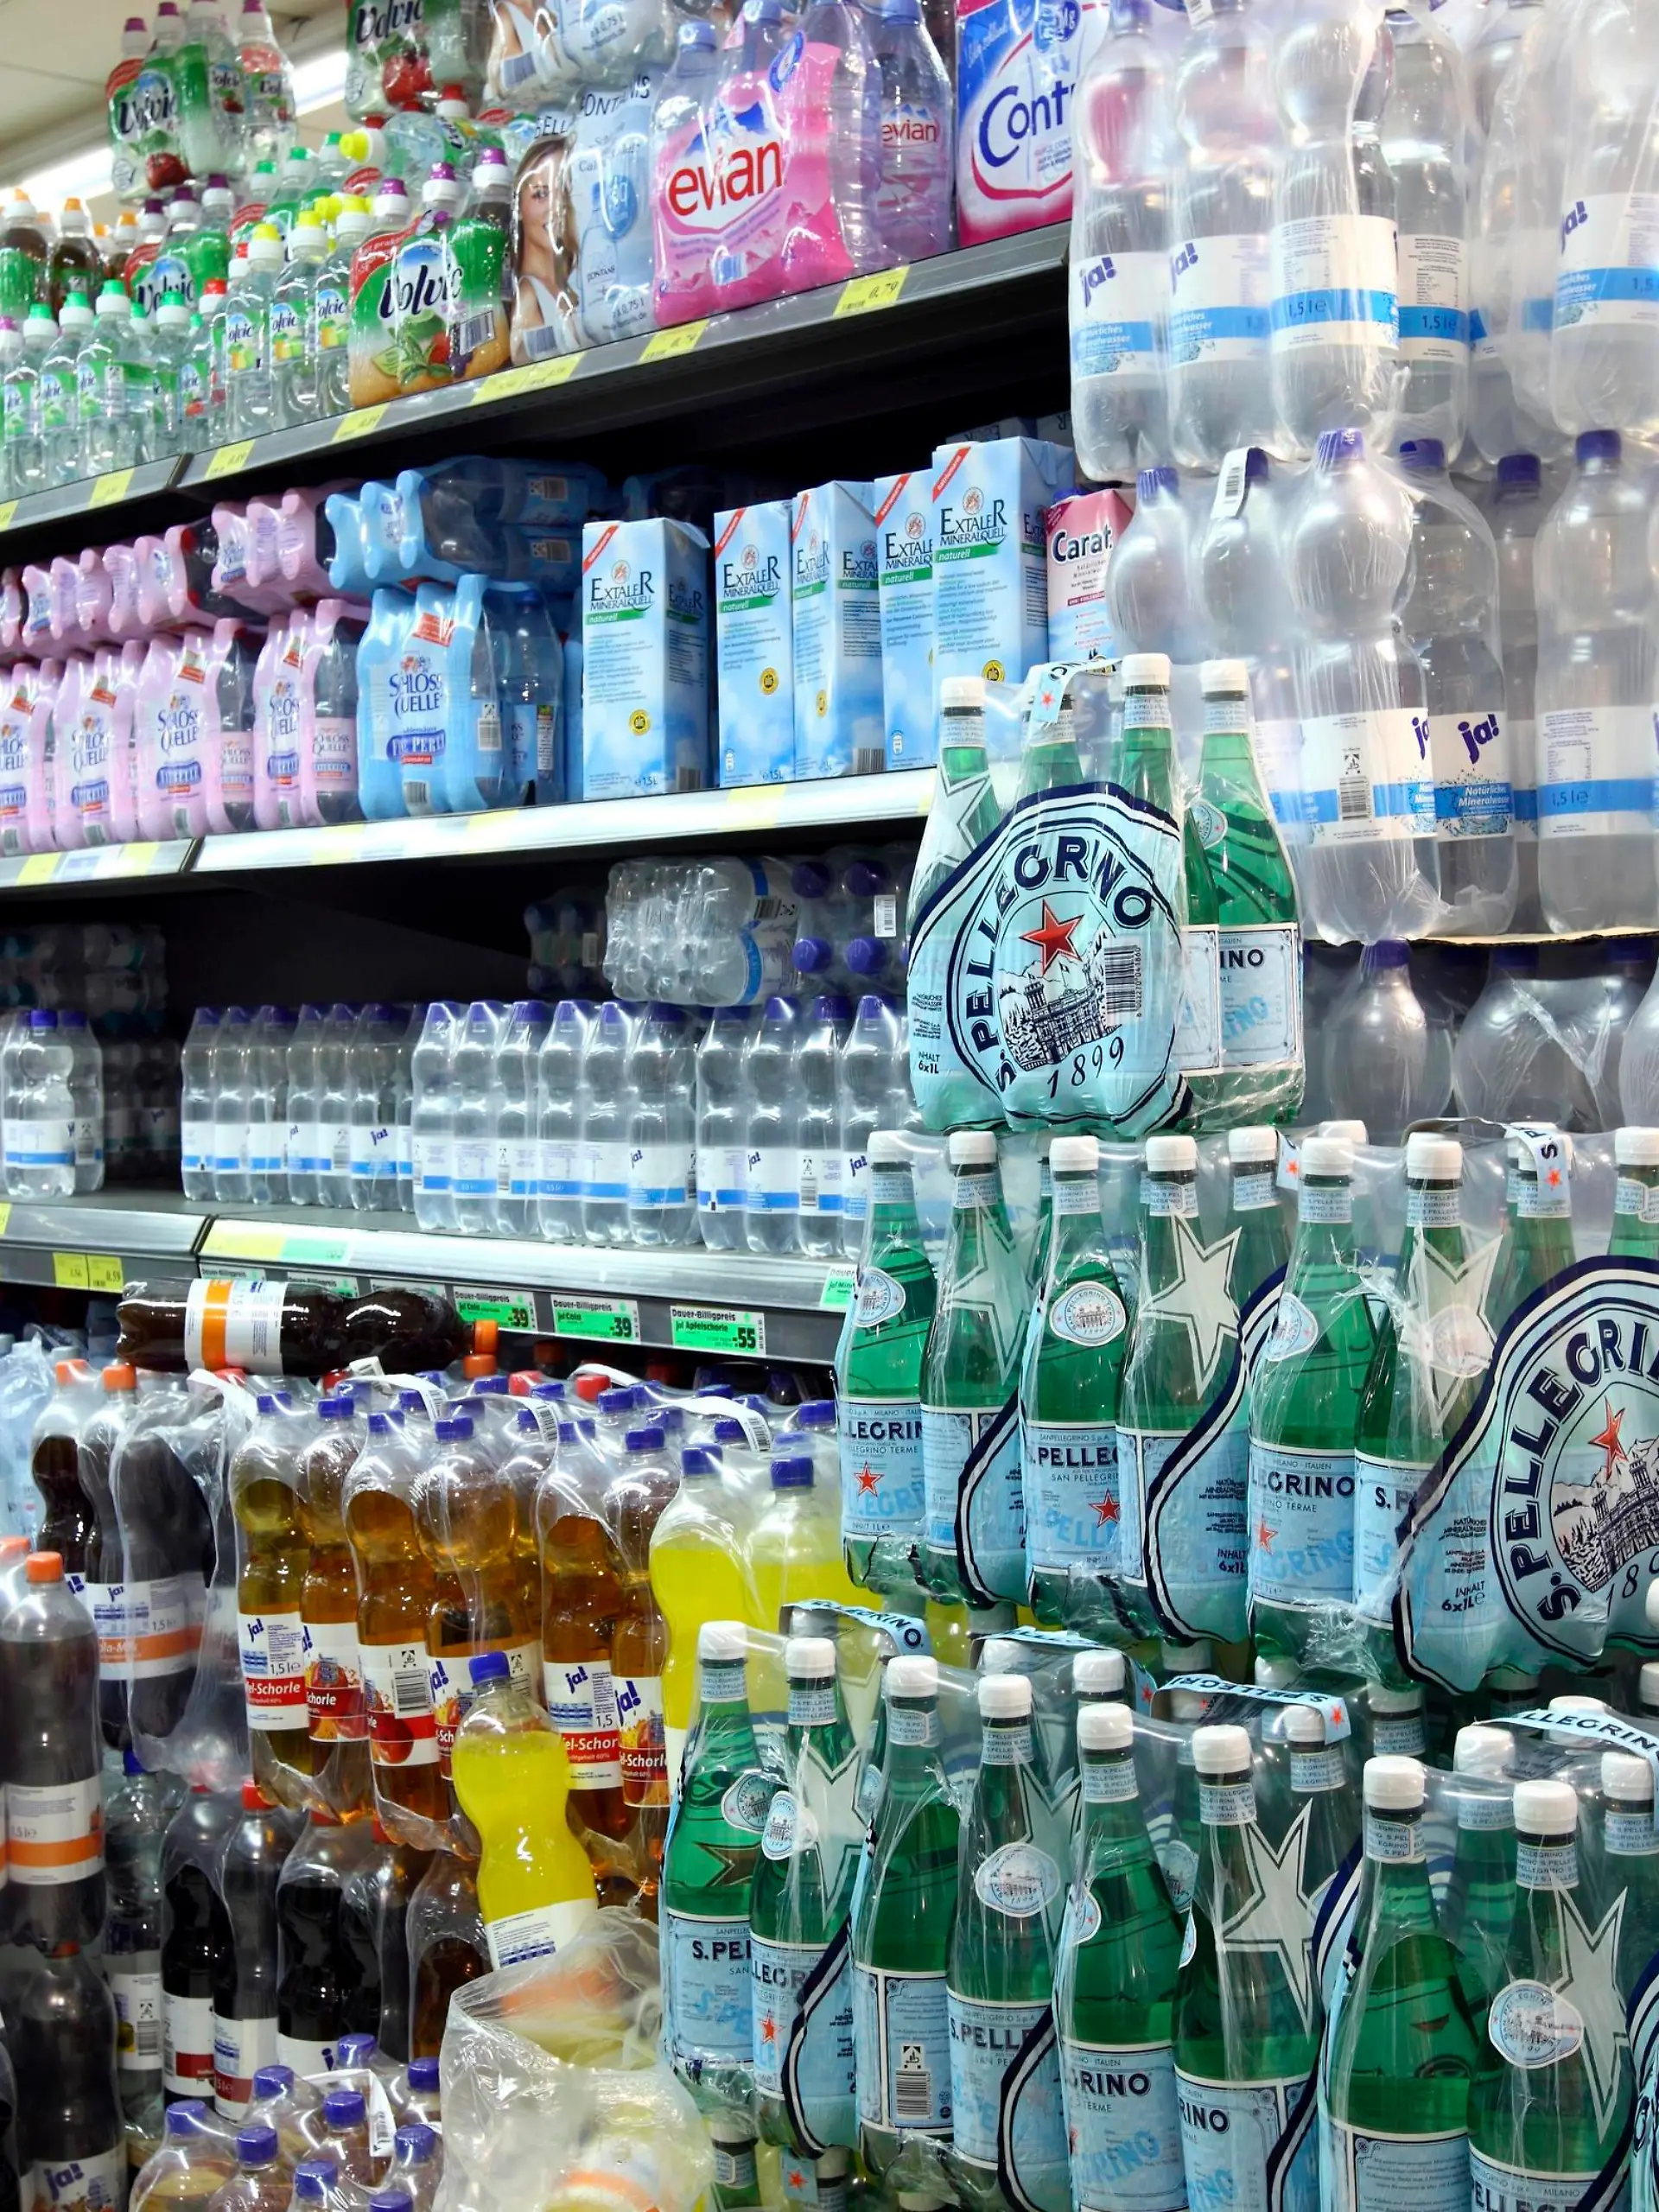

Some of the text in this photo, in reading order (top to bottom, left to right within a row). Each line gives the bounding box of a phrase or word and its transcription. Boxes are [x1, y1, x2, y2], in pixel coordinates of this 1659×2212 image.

[881, 119, 939, 143] evian
[667, 139, 783, 216] evian
[1171, 243, 1198, 296] ja!
[379, 263, 463, 319] Volvic
[1079, 257, 1117, 308] ja!
[940, 499, 1008, 536] EXTALER
[940, 528, 1007, 547] MINERALQUELL
[938, 549, 971, 562] naturell
[723, 556, 781, 588] EXTALER
[885, 572, 914, 585] naturell
[591, 571, 655, 602] EXTALER
[724, 582, 779, 598] MINERALQUELL
[590, 594, 653, 612] MINERALQUELL
[390, 672, 442, 697] SHLOSS
[1458, 713, 1500, 765] ja!
[1047, 1036, 1125, 1099] 1899
[747, 1151, 761, 1172] ja!
[849, 1154, 868, 1178] ja!
[454, 1291, 511, 1303] Dauer-Billigpreis
[553, 1299, 613, 1312] Dauer-Billigpreis
[566, 1313, 582, 1321] Cola
[671, 1308, 736, 1322] Dauer-Billigpreis
[890, 1446, 918, 1455] TERME
[1031, 1446, 1119, 1467] .PELLE
[1305, 1461, 1332, 1471] ITALIEN
[1286, 1502, 1318, 1513] TERME
[247, 1618, 264, 1643] ja!
[270, 1662, 285, 1676] 1,5
[564, 1665, 588, 1694] ja!
[595, 1715, 613, 1729] 1,5
[729, 1967, 750, 1975] SAN
[1095, 2058, 1121, 2068] ITALIEN
[1084, 2101, 1112, 2113] TERME
[44, 2162, 85, 2202] ja!
[1543, 2187, 1581, 2196] MILANO
